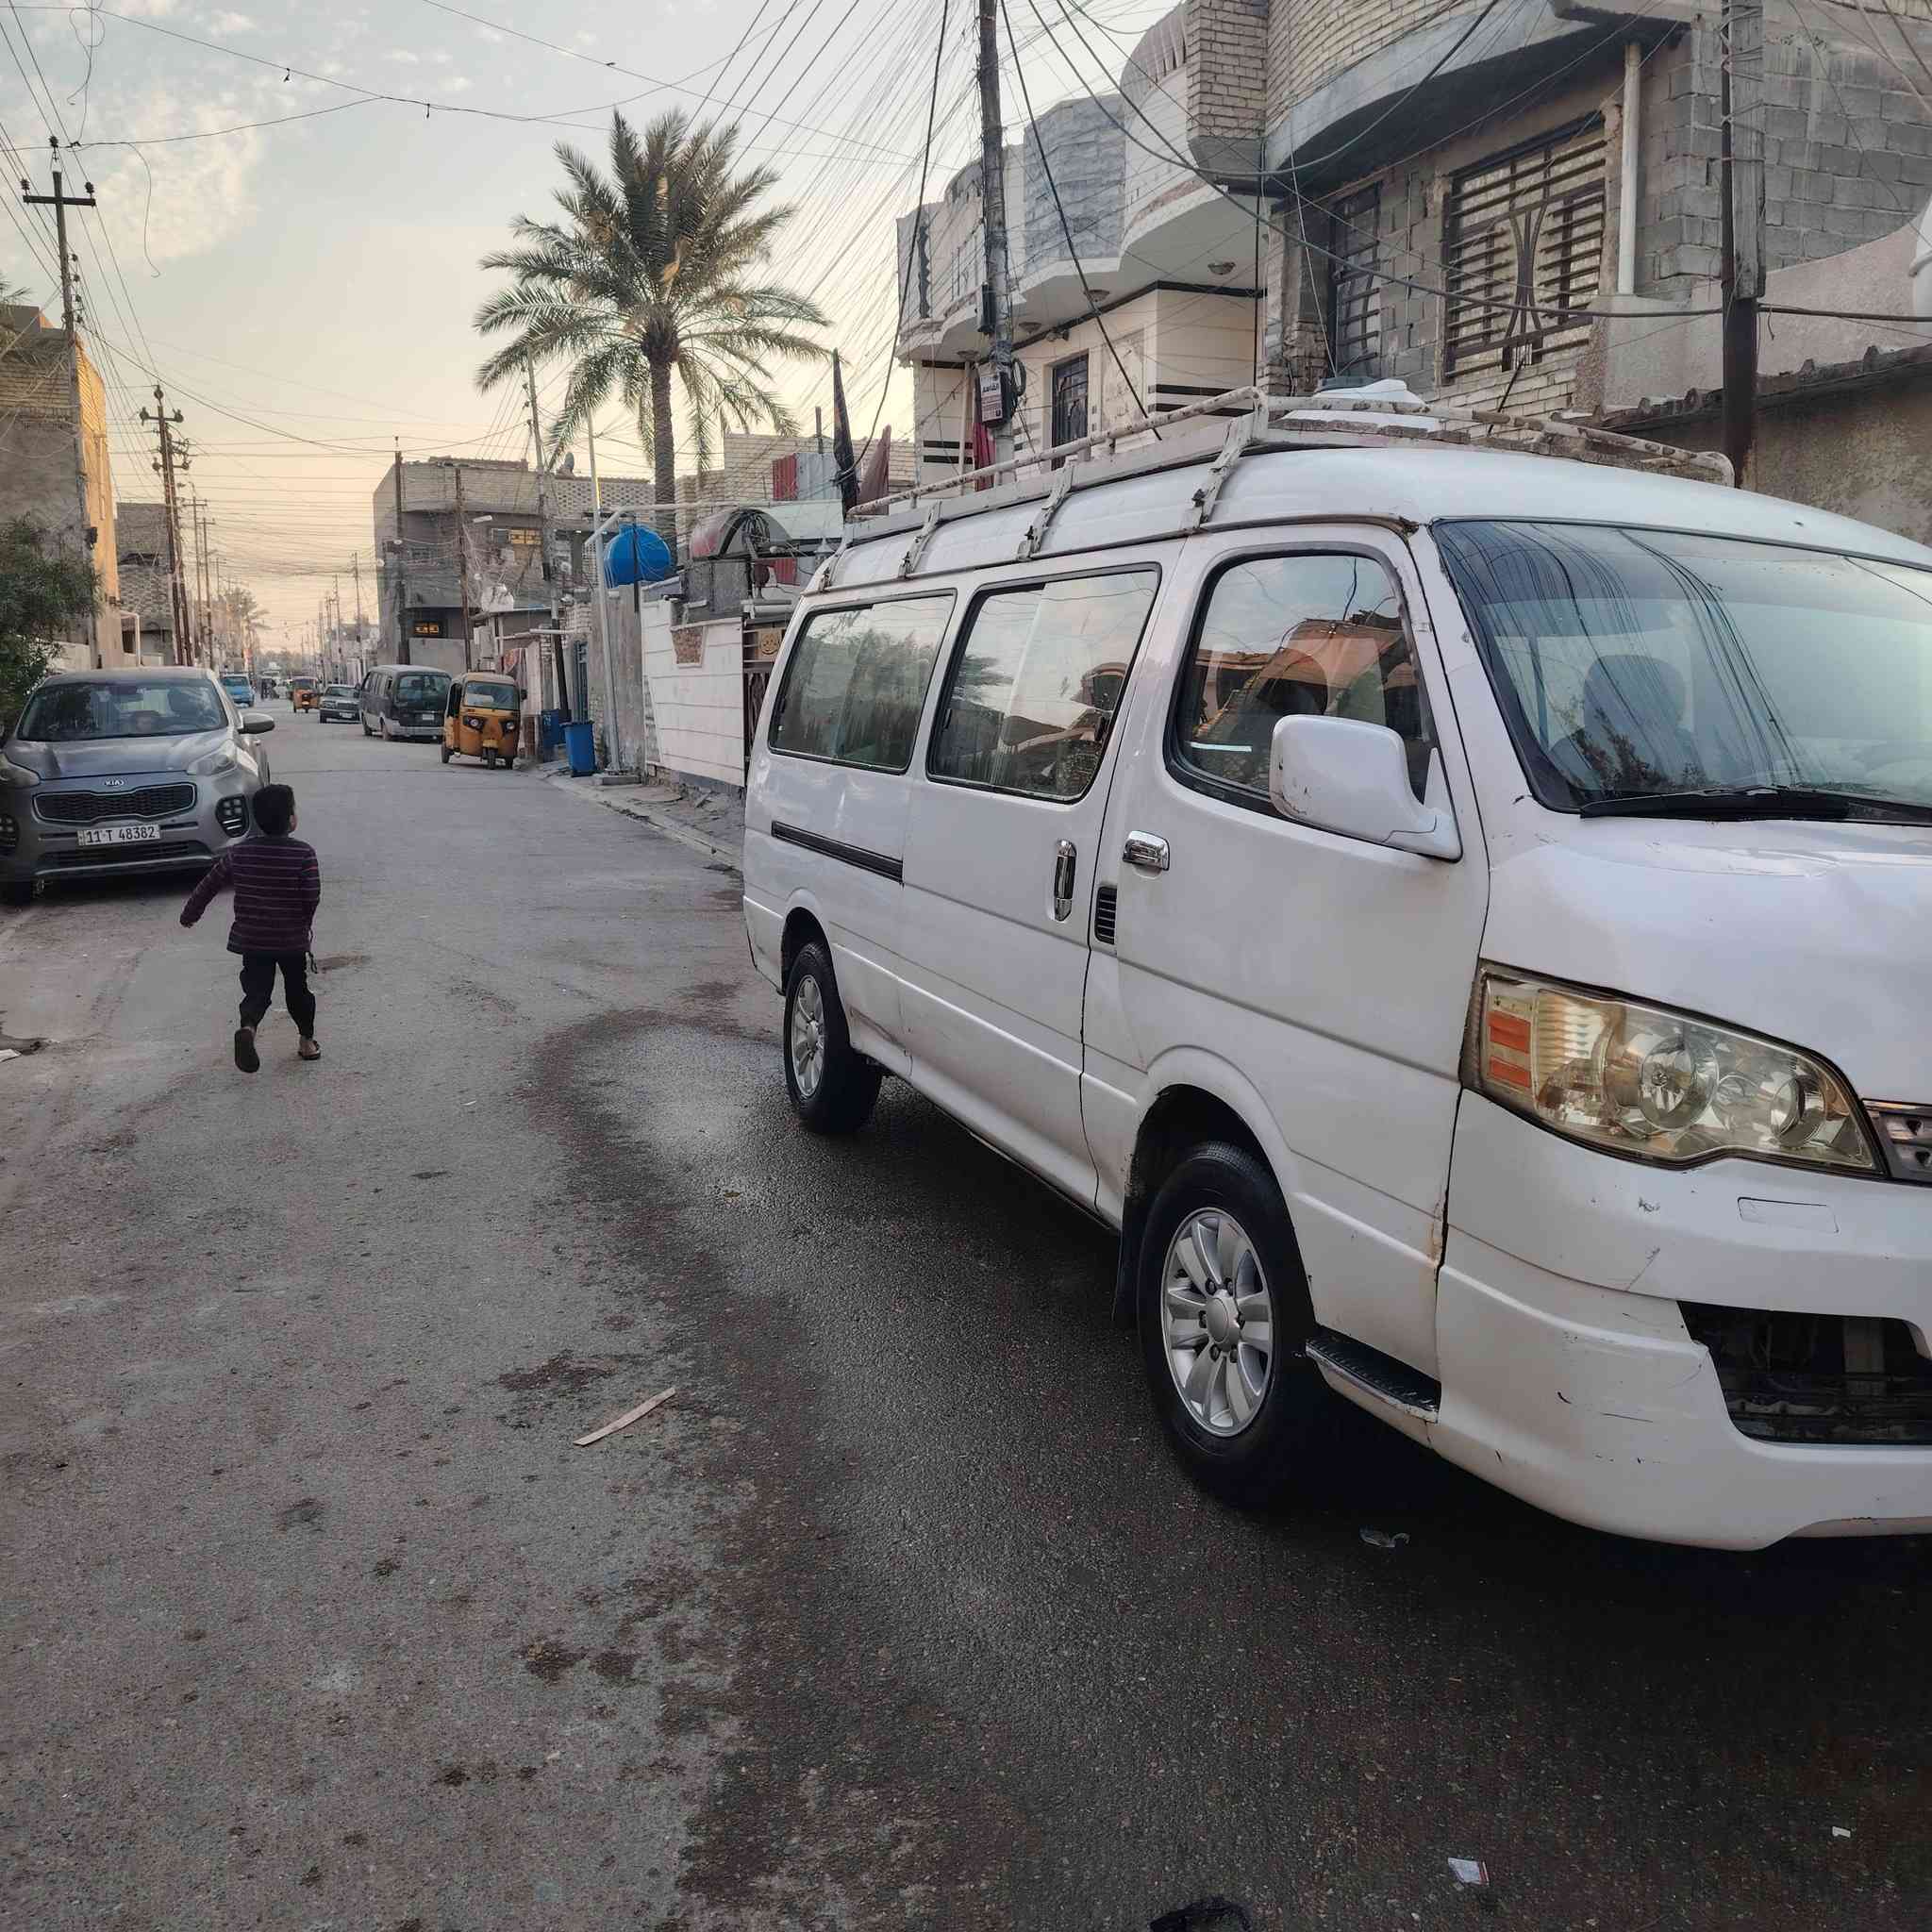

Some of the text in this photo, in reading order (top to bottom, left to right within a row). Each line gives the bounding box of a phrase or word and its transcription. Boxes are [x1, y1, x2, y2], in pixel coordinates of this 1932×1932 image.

[86, 830, 101, 843] 11
[106, 829, 113, 841] T
[119, 826, 156, 840] 48382
